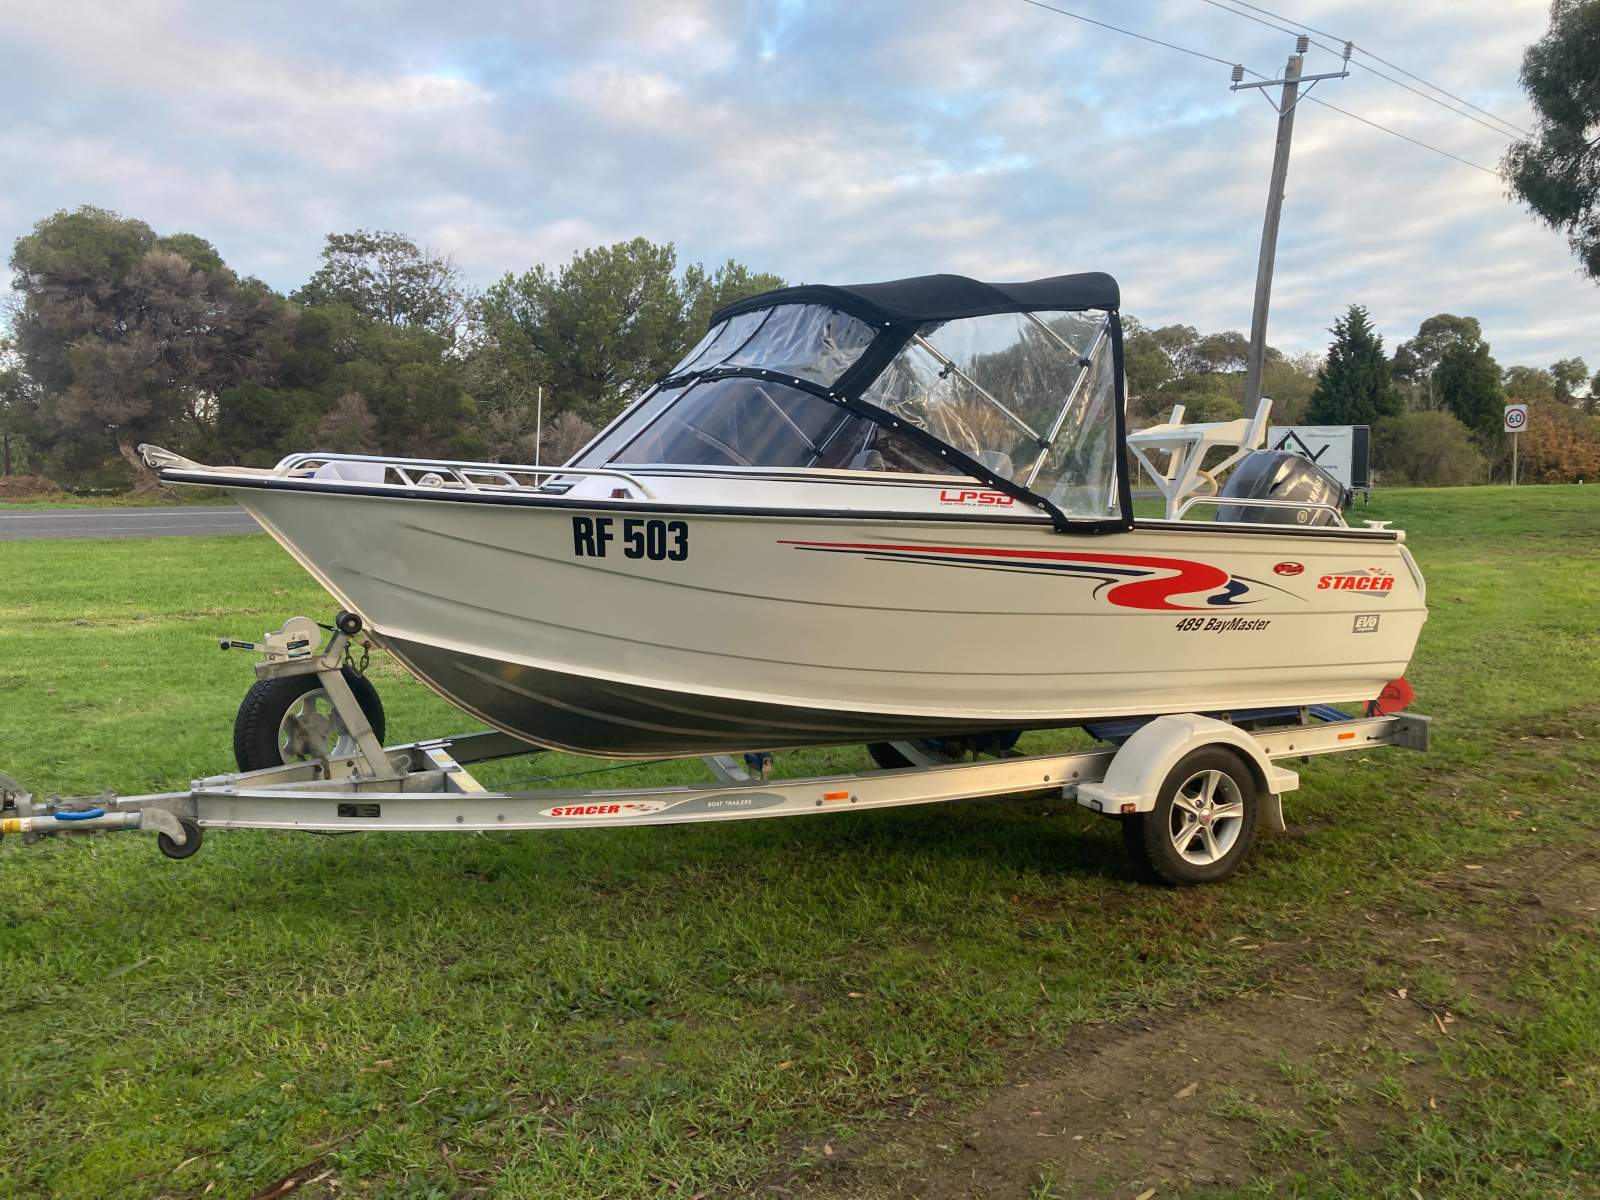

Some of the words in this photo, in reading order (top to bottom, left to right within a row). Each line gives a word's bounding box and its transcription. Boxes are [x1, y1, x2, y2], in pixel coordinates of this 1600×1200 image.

[1508, 413, 1522, 423] 60
[940, 490, 1014, 505] LPSD
[572, 516, 614, 557] RF
[623, 518, 689, 561] 503
[1317, 575, 1395, 591] STACER
[1175, 617, 1205, 631] 489
[1203, 617, 1271, 634] BayMaster
[1354, 615, 1379, 628] EVO
[551, 804, 621, 817] STACER
